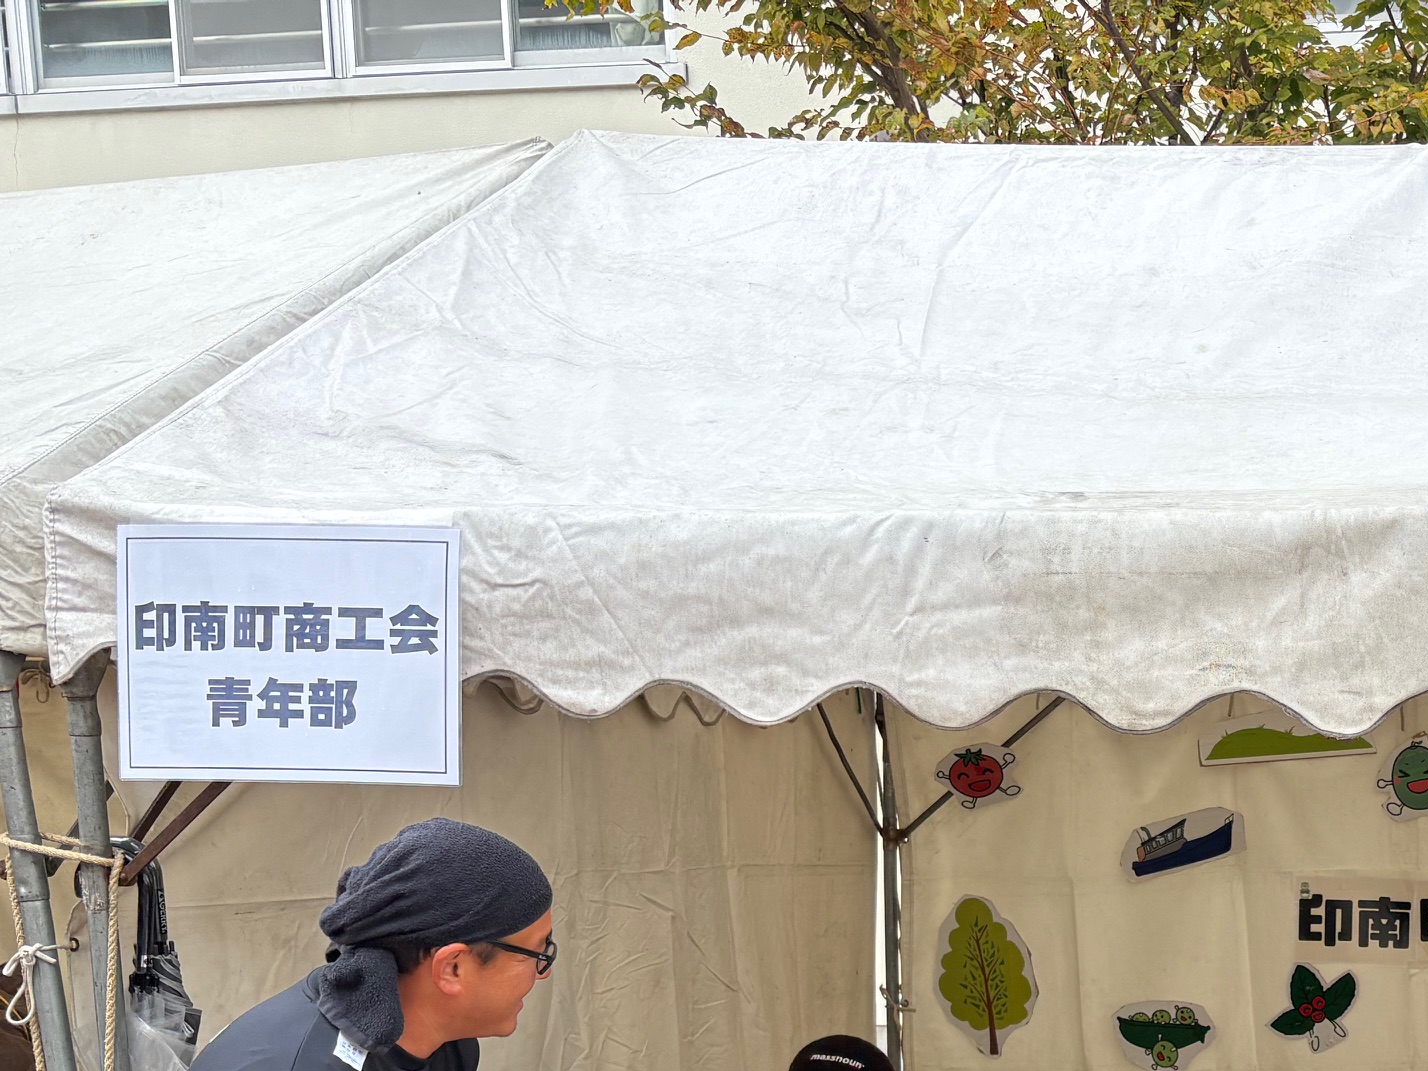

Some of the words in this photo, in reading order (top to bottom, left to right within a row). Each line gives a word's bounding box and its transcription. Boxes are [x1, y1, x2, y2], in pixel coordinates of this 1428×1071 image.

[134, 600, 440, 656] 印南町商工会
[206, 676, 359, 730] 青年部
